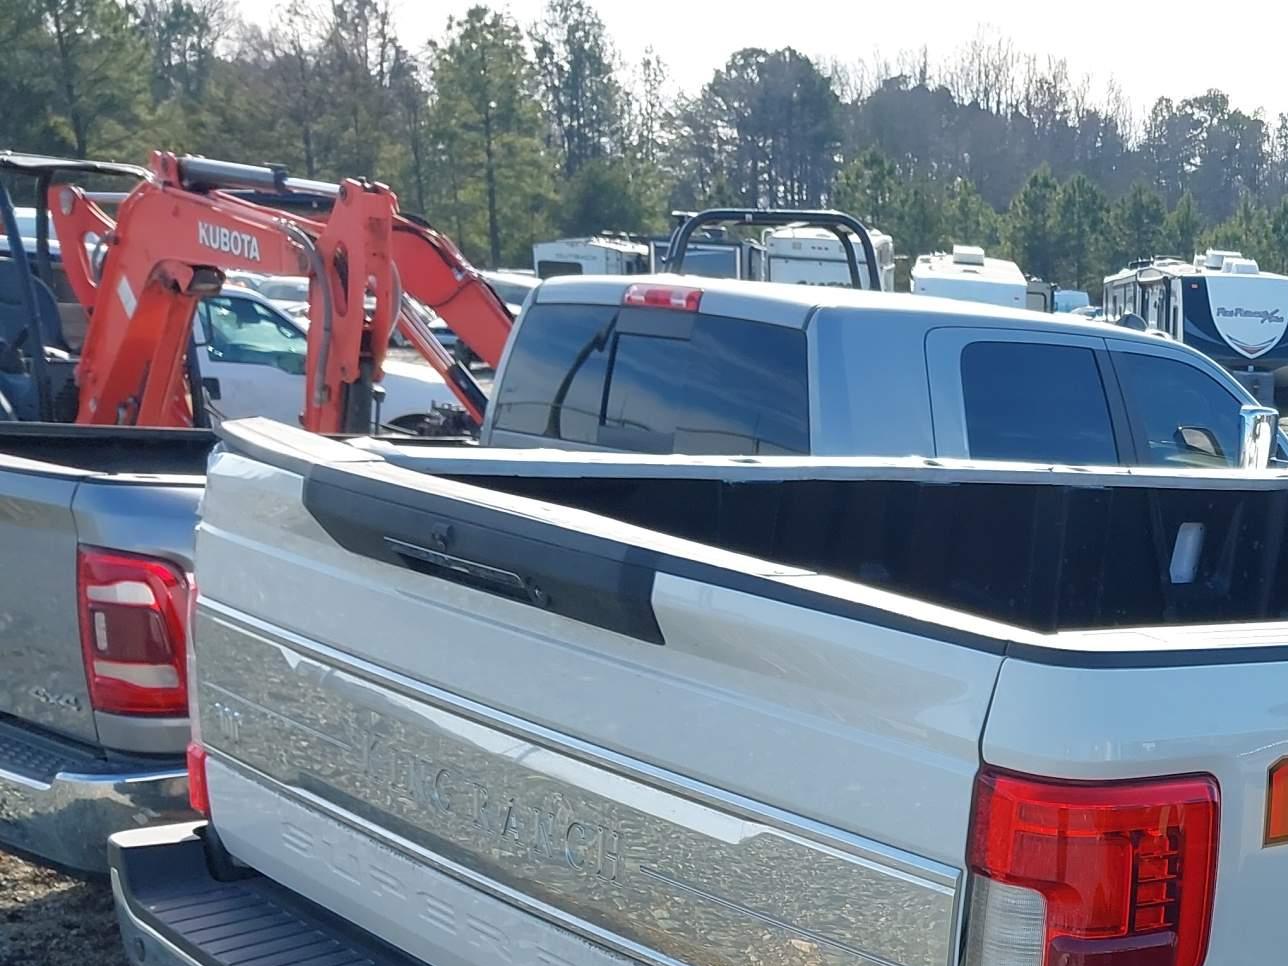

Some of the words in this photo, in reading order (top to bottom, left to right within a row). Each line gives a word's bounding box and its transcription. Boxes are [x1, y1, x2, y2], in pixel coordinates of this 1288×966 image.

[198, 220, 261, 262] KUBOTA
[362, 731, 453, 815] KING
[466, 782, 624, 889] RANCH
[281, 820, 514, 964] SUPER
